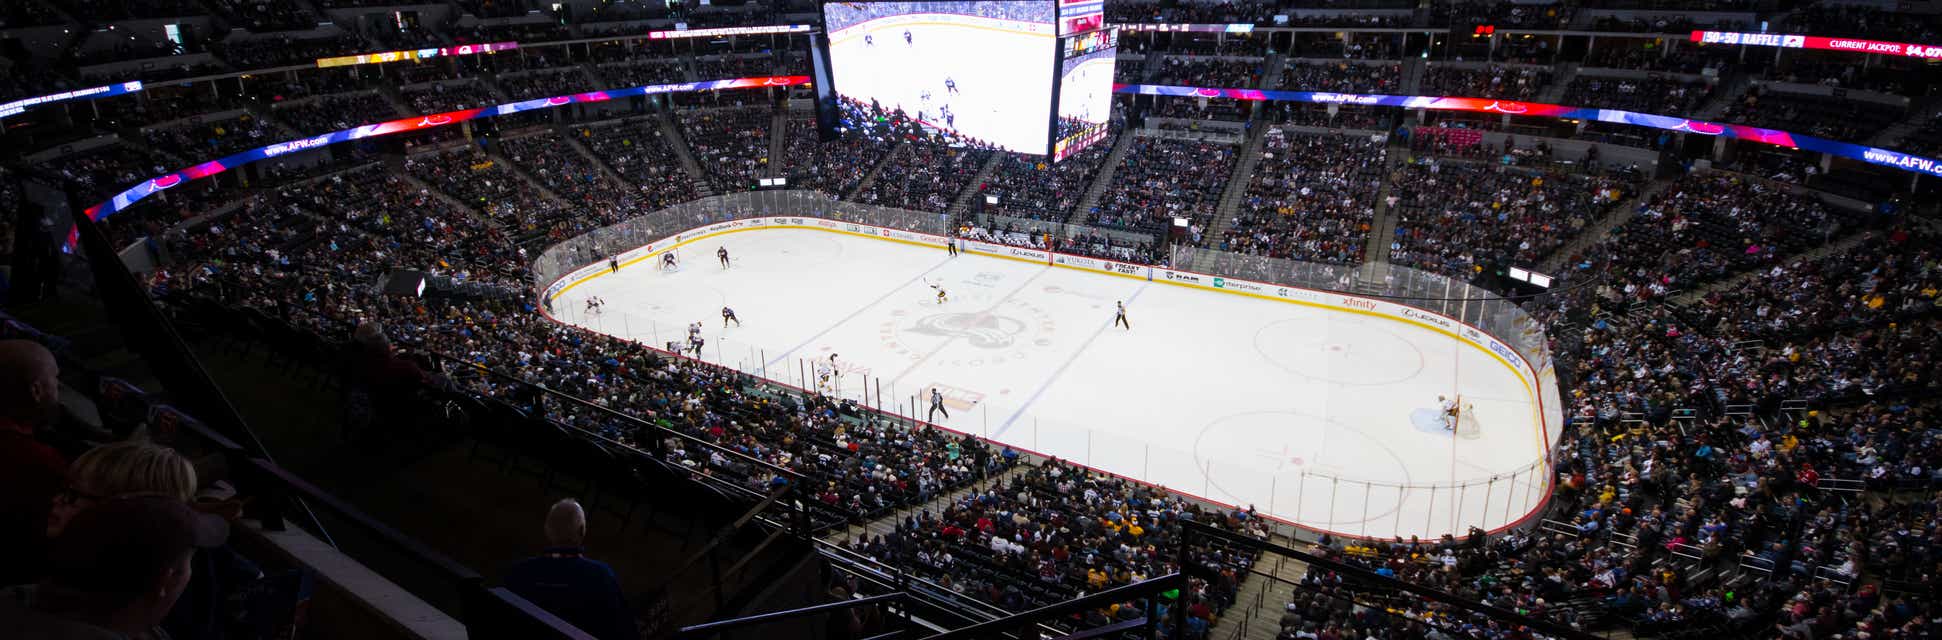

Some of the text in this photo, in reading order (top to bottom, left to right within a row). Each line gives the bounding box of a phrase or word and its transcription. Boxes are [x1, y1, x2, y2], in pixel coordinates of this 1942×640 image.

[1743, 34, 1780, 46] RAFFLE
[1829, 40, 1942, 57] CURRENT JACKPOT: $4,07
[644, 84, 695, 94] www.AFW.com
[1312, 94, 1377, 104] www.AFW.com
[264, 137, 328, 156] www.AFW.com
[1343, 297, 1377, 310] xfinity
[1415, 313, 1450, 327] LEXUS
[1490, 341, 1521, 368] GEICO
